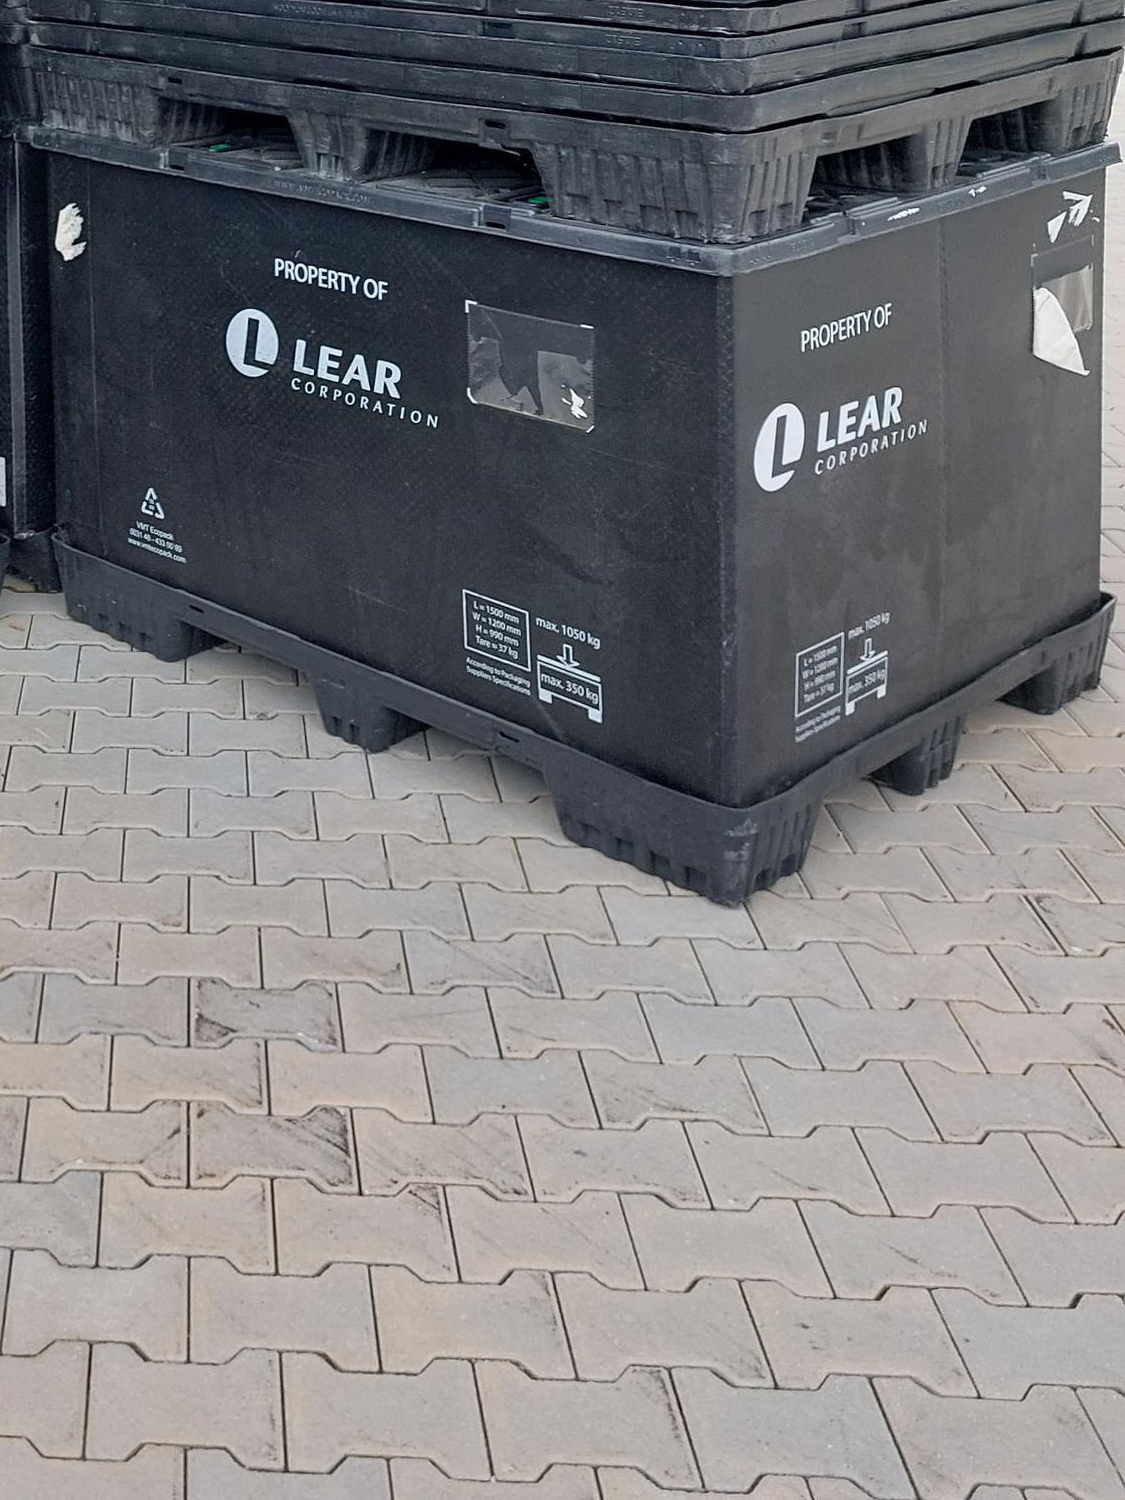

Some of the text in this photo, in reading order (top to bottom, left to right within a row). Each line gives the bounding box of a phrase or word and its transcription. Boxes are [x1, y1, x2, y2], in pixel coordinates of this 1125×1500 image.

[274, 257, 389, 300] PROPERTY OF
[800, 302, 893, 353] PROPERTY OF
[292, 338, 402, 399] LEAR
[290, 377, 439, 428] CORPORATION
[816, 386, 903, 453] LEAR
[814, 419, 928, 476] CORPORATION
[472, 611, 481, 621] W
[488, 617, 506, 630] 1200
[506, 625, 522, 636] mm
[473, 600, 478, 610] L
[486, 605, 504, 618] 1500
[504, 613, 520, 624] mm
[475, 624, 482, 633] H
[504, 636, 519, 647] mm
[475, 635, 491, 648] Tare
[508, 646, 518, 660] kg
[536, 617, 601, 650] max. 1050 kg
[466, 657, 494, 674] According
[501, 670, 531, 688] Packaging
[540, 673, 599, 705] max. 350 kg
